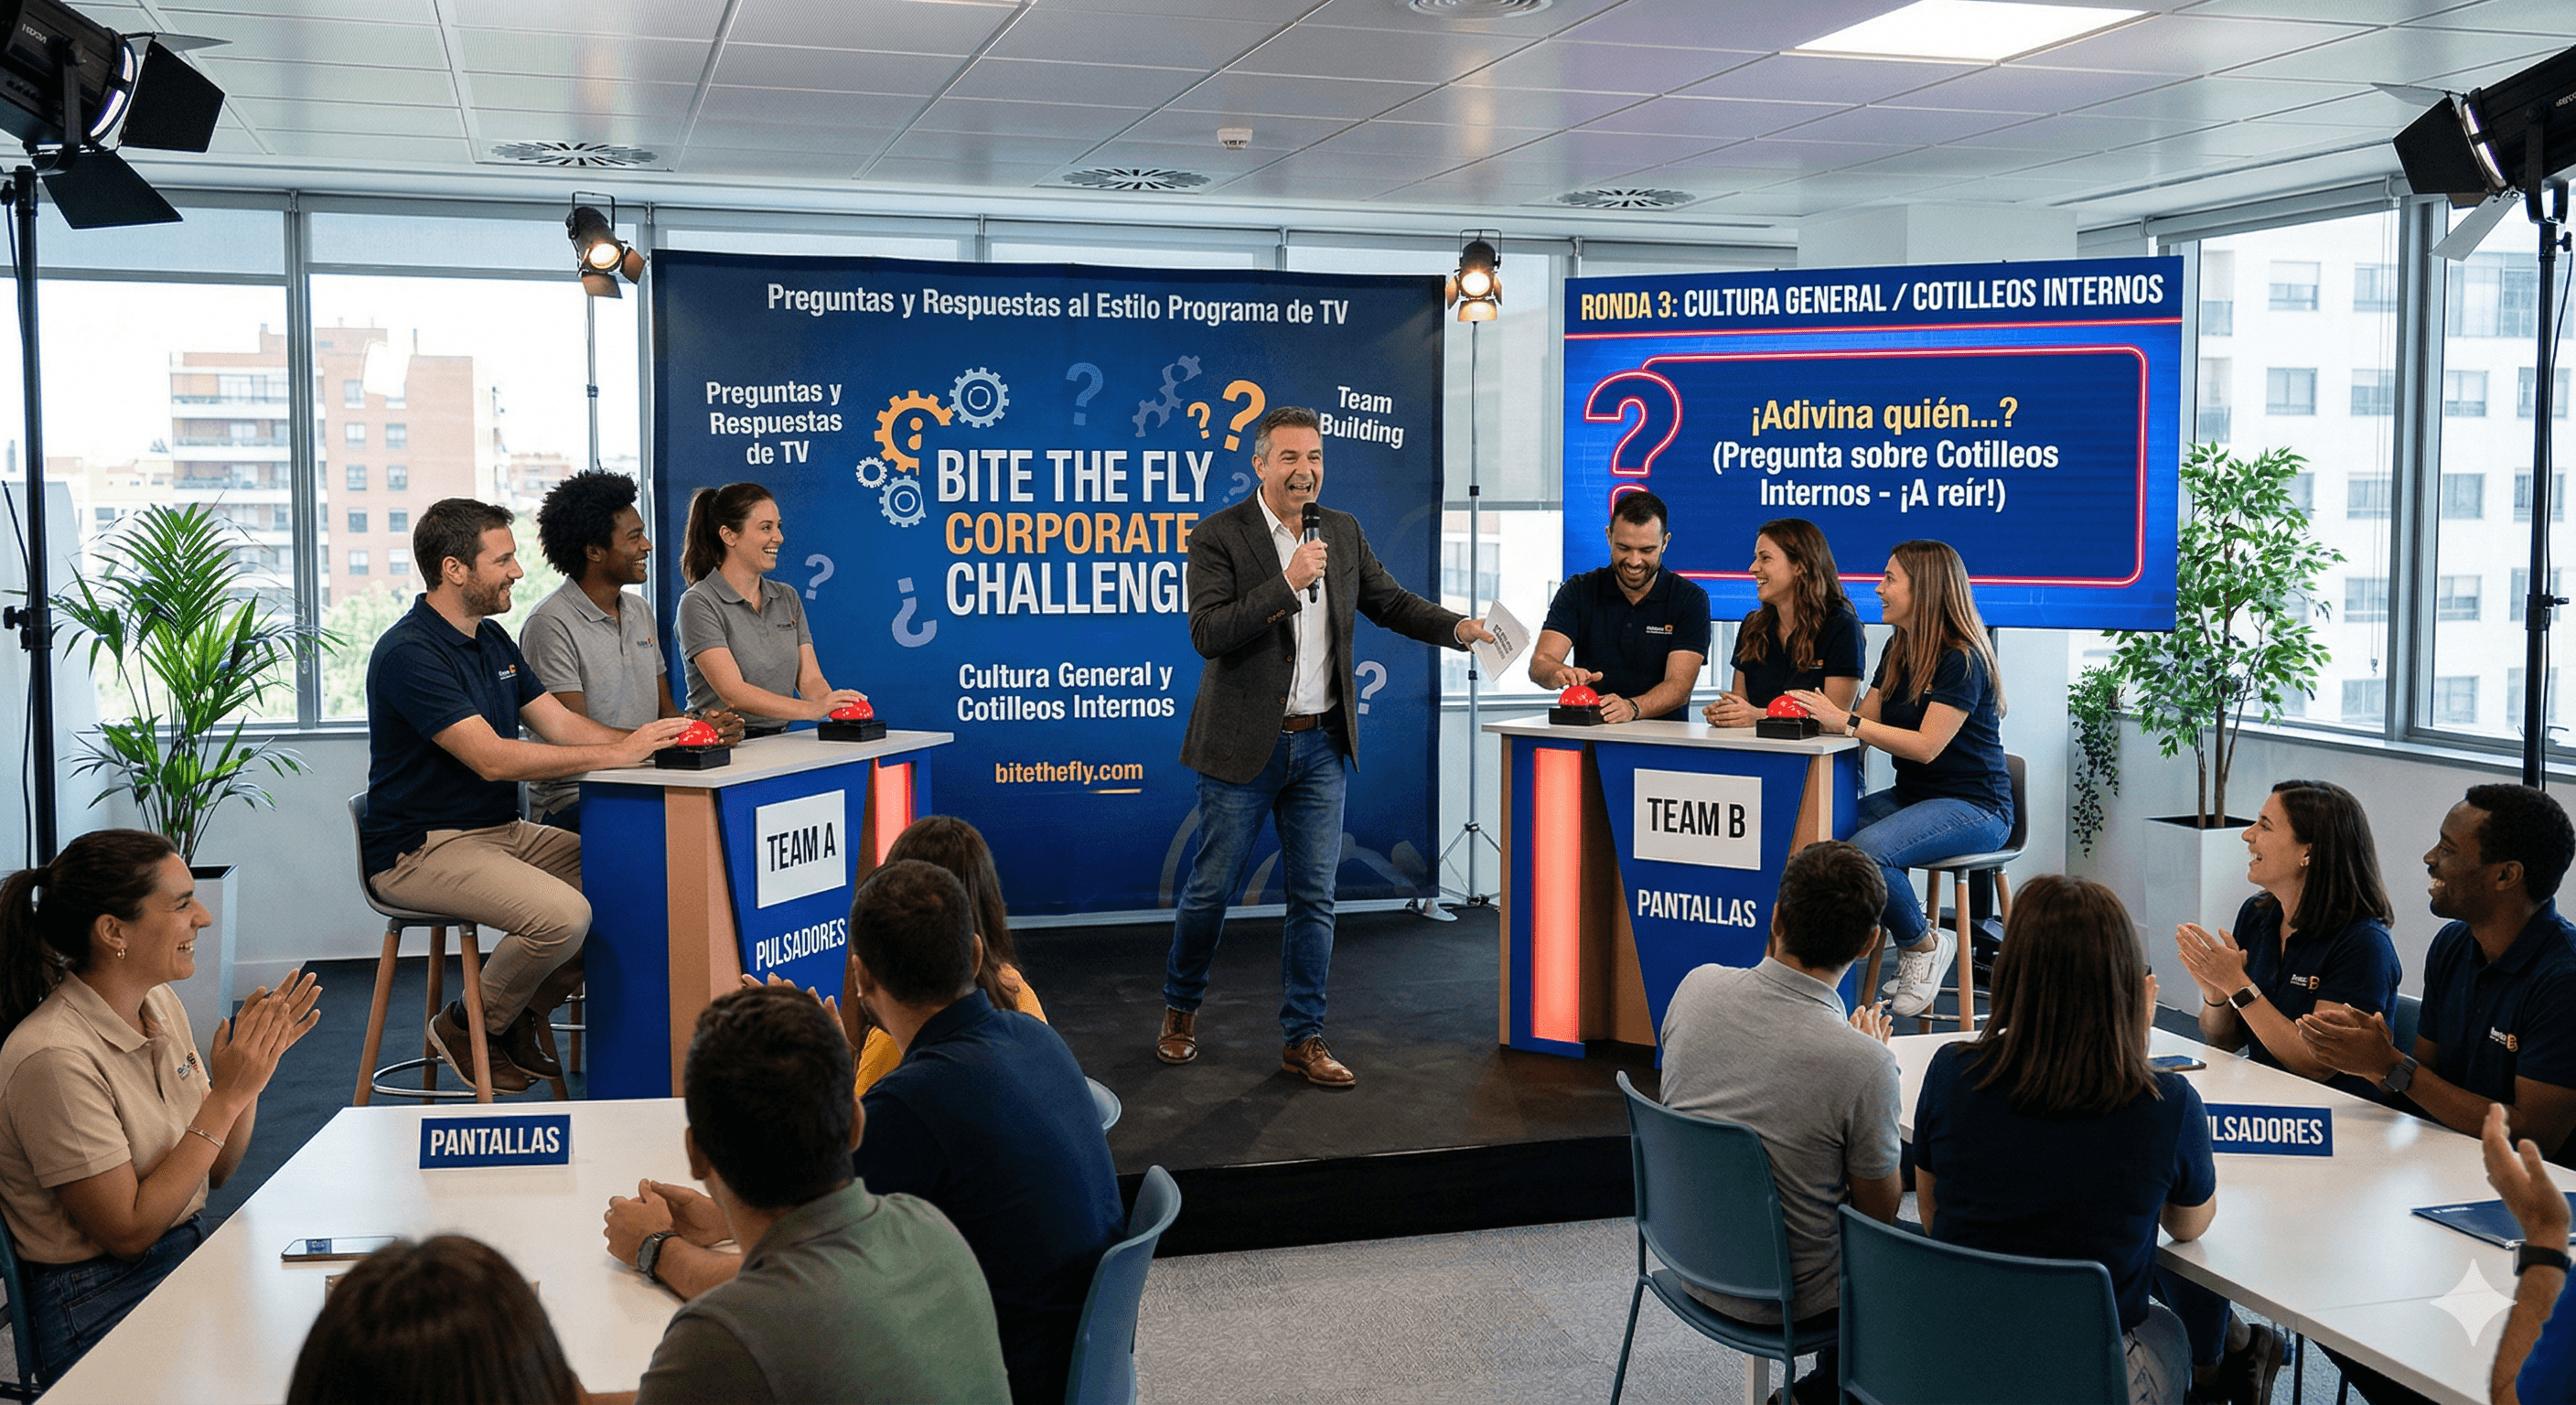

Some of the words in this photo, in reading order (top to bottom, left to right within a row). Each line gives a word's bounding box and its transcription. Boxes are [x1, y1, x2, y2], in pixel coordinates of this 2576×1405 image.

[767, 284, 895, 316] Preguntas
[901, 294, 916, 318] y
[923, 288, 1061, 321] Respuestas
[1068, 293, 1089, 317] al
[1097, 293, 1161, 319] Estilo
[1168, 295, 1279, 327] Programa
[1286, 298, 1314, 324] de
[1319, 299, 1349, 325] TV
[1581, 291, 1653, 321] RONDA
[1658, 291, 1679, 318] 3:
[1684, 287, 1780, 317] CULTURA
[1786, 284, 1887, 315] GENERAL
[1892, 283, 1908, 311] /
[1913, 278, 2037, 311] COTILLEOS
[2044, 273, 2164, 306] INTERNOS
[706, 381, 823, 409] Preguntas
[829, 383, 843, 406] y
[1337, 385, 1392, 414] Team
[710, 411, 843, 438] Respuestas
[1320, 413, 1404, 450] Building
[1752, 399, 1873, 436] ¡Adivina
[1884, 396, 2018, 435] quién...?
[746, 443, 774, 465] de
[779, 440, 810, 464] TV
[1712, 441, 1842, 476] (Pregunta
[1851, 441, 1928, 468] sobre
[1937, 439, 2059, 468] Cotilleos
[938, 449, 1034, 502] BITE
[1046, 450, 1128, 502] THE
[1143, 450, 1214, 502] FLY
[1761, 478, 1871, 506] Internos
[1901, 478, 1929, 513] ¡A
[1937, 477, 2006, 513] reír!)
[945, 511, 1199, 555] CORPORATE
[959, 663, 1050, 690] Cultura
[1058, 661, 1152, 688] General
[1159, 666, 1173, 691] y
[957, 695, 1066, 722] Cotilleos
[1074, 694, 1175, 718] Internos
[995, 760, 1143, 785] bitethefly.com
[1647, 797, 1720, 837] TEAM
[1728, 803, 1745, 839] B
[767, 825, 819, 873] TEAM
[823, 821, 836, 859] A
[1637, 889, 1756, 928] PANTALLAS
[757, 917, 846, 971] PULSADORES
[430, 1126, 561, 1156] PANTALLAS
[2206, 1115, 2324, 1145] LSADORES
